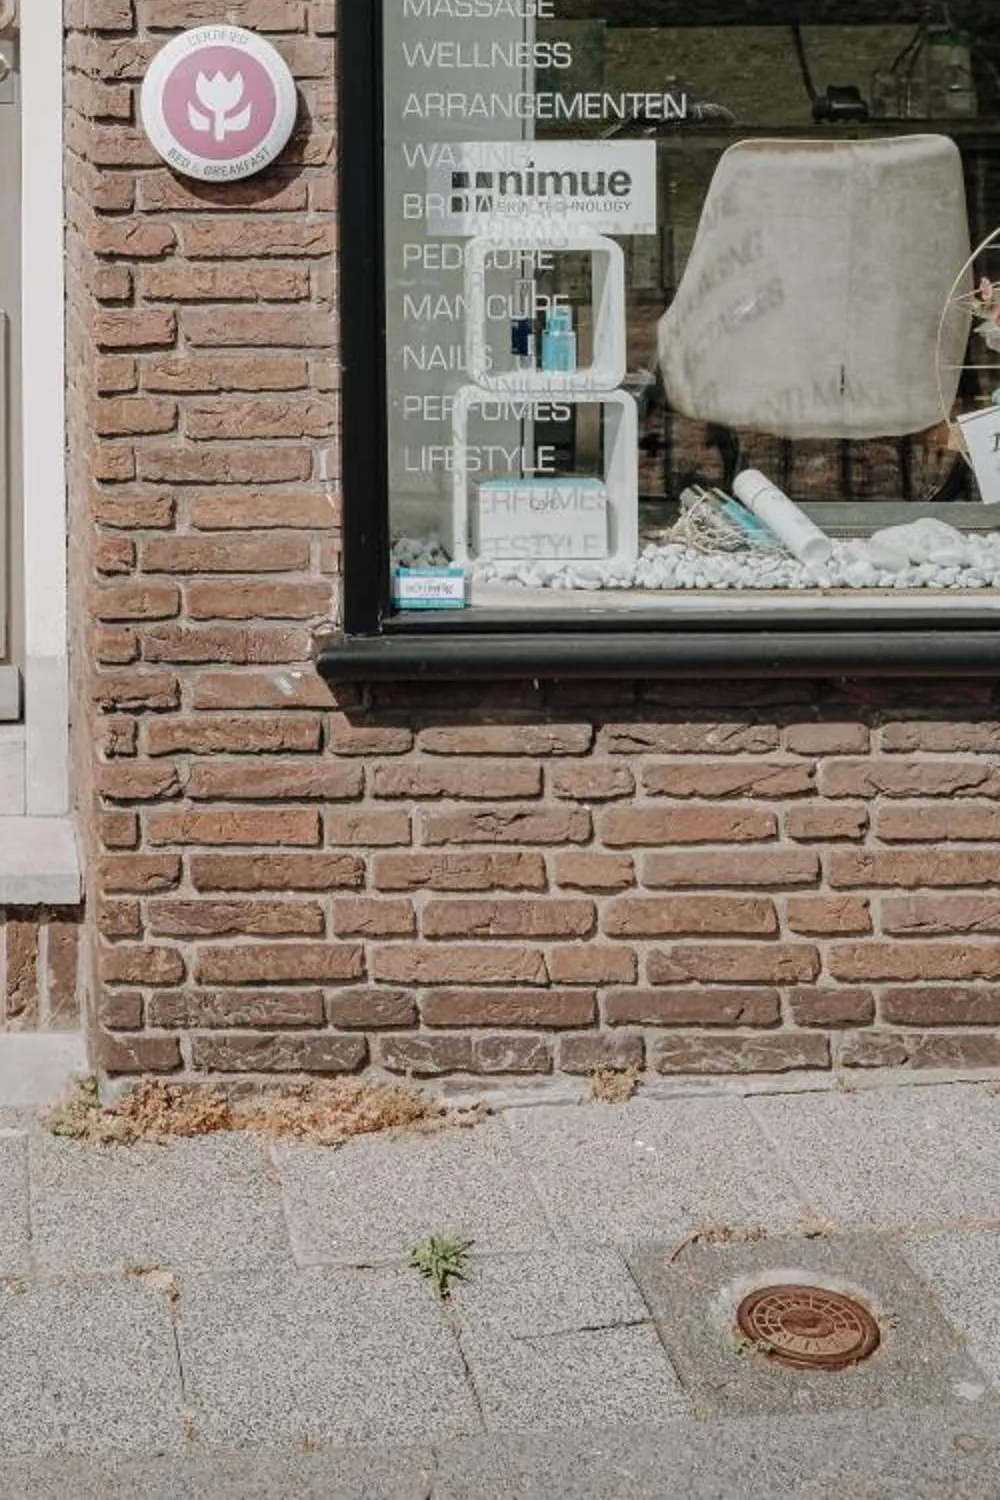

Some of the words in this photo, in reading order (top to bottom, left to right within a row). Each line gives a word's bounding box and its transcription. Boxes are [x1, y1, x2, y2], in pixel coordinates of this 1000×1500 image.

[402, 42, 573, 68] WELLNESS
[402, 92, 688, 119] ARRANGEMENTEN
[202, 145, 273, 178] BREAKFAST
[499, 160, 633, 197] nimue
[403, 244, 555, 270] PEDURE
[403, 295, 570, 320] MANCURE
[404, 446, 556, 472] LIFESTYLE
